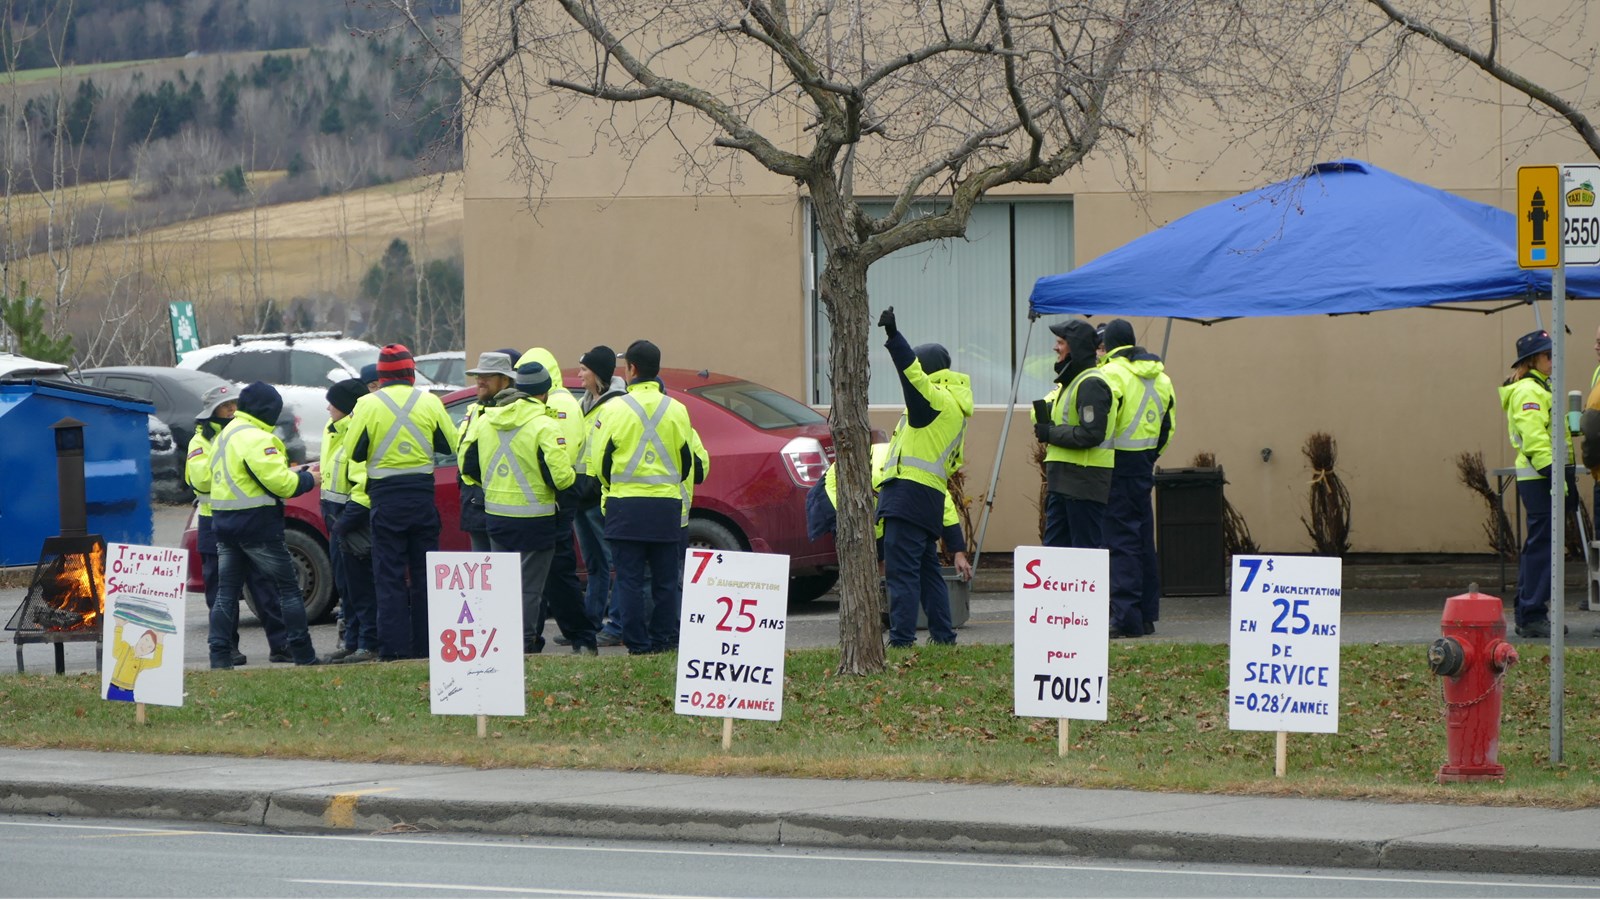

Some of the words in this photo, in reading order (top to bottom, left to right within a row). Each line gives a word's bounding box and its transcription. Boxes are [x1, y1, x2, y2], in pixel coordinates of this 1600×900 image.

[1568, 193, 1580, 203] TAXI
[1565, 217, 1599, 245] 2550
[118, 545, 183, 562] Travailler
[434, 556, 491, 590] PAYÉ
[1023, 559, 1096, 592] Sécurité
[457, 592, 474, 624] À
[689, 613, 705, 624] EN
[715, 596, 757, 633] 25
[758, 618, 784, 630] ANS
[1240, 620, 1257, 632] EN
[1270, 598, 1310, 635] 25
[1312, 624, 1336, 636] ANS
[440, 627, 499, 662] 85%
[721, 642, 740, 656] DE
[1047, 650, 1077, 663] pour
[1272, 643, 1292, 657] DE
[685, 659, 774, 685] SERVICE
[1244, 662, 1329, 687] SERVICE
[1033, 674, 1103, 704] TOUS!
